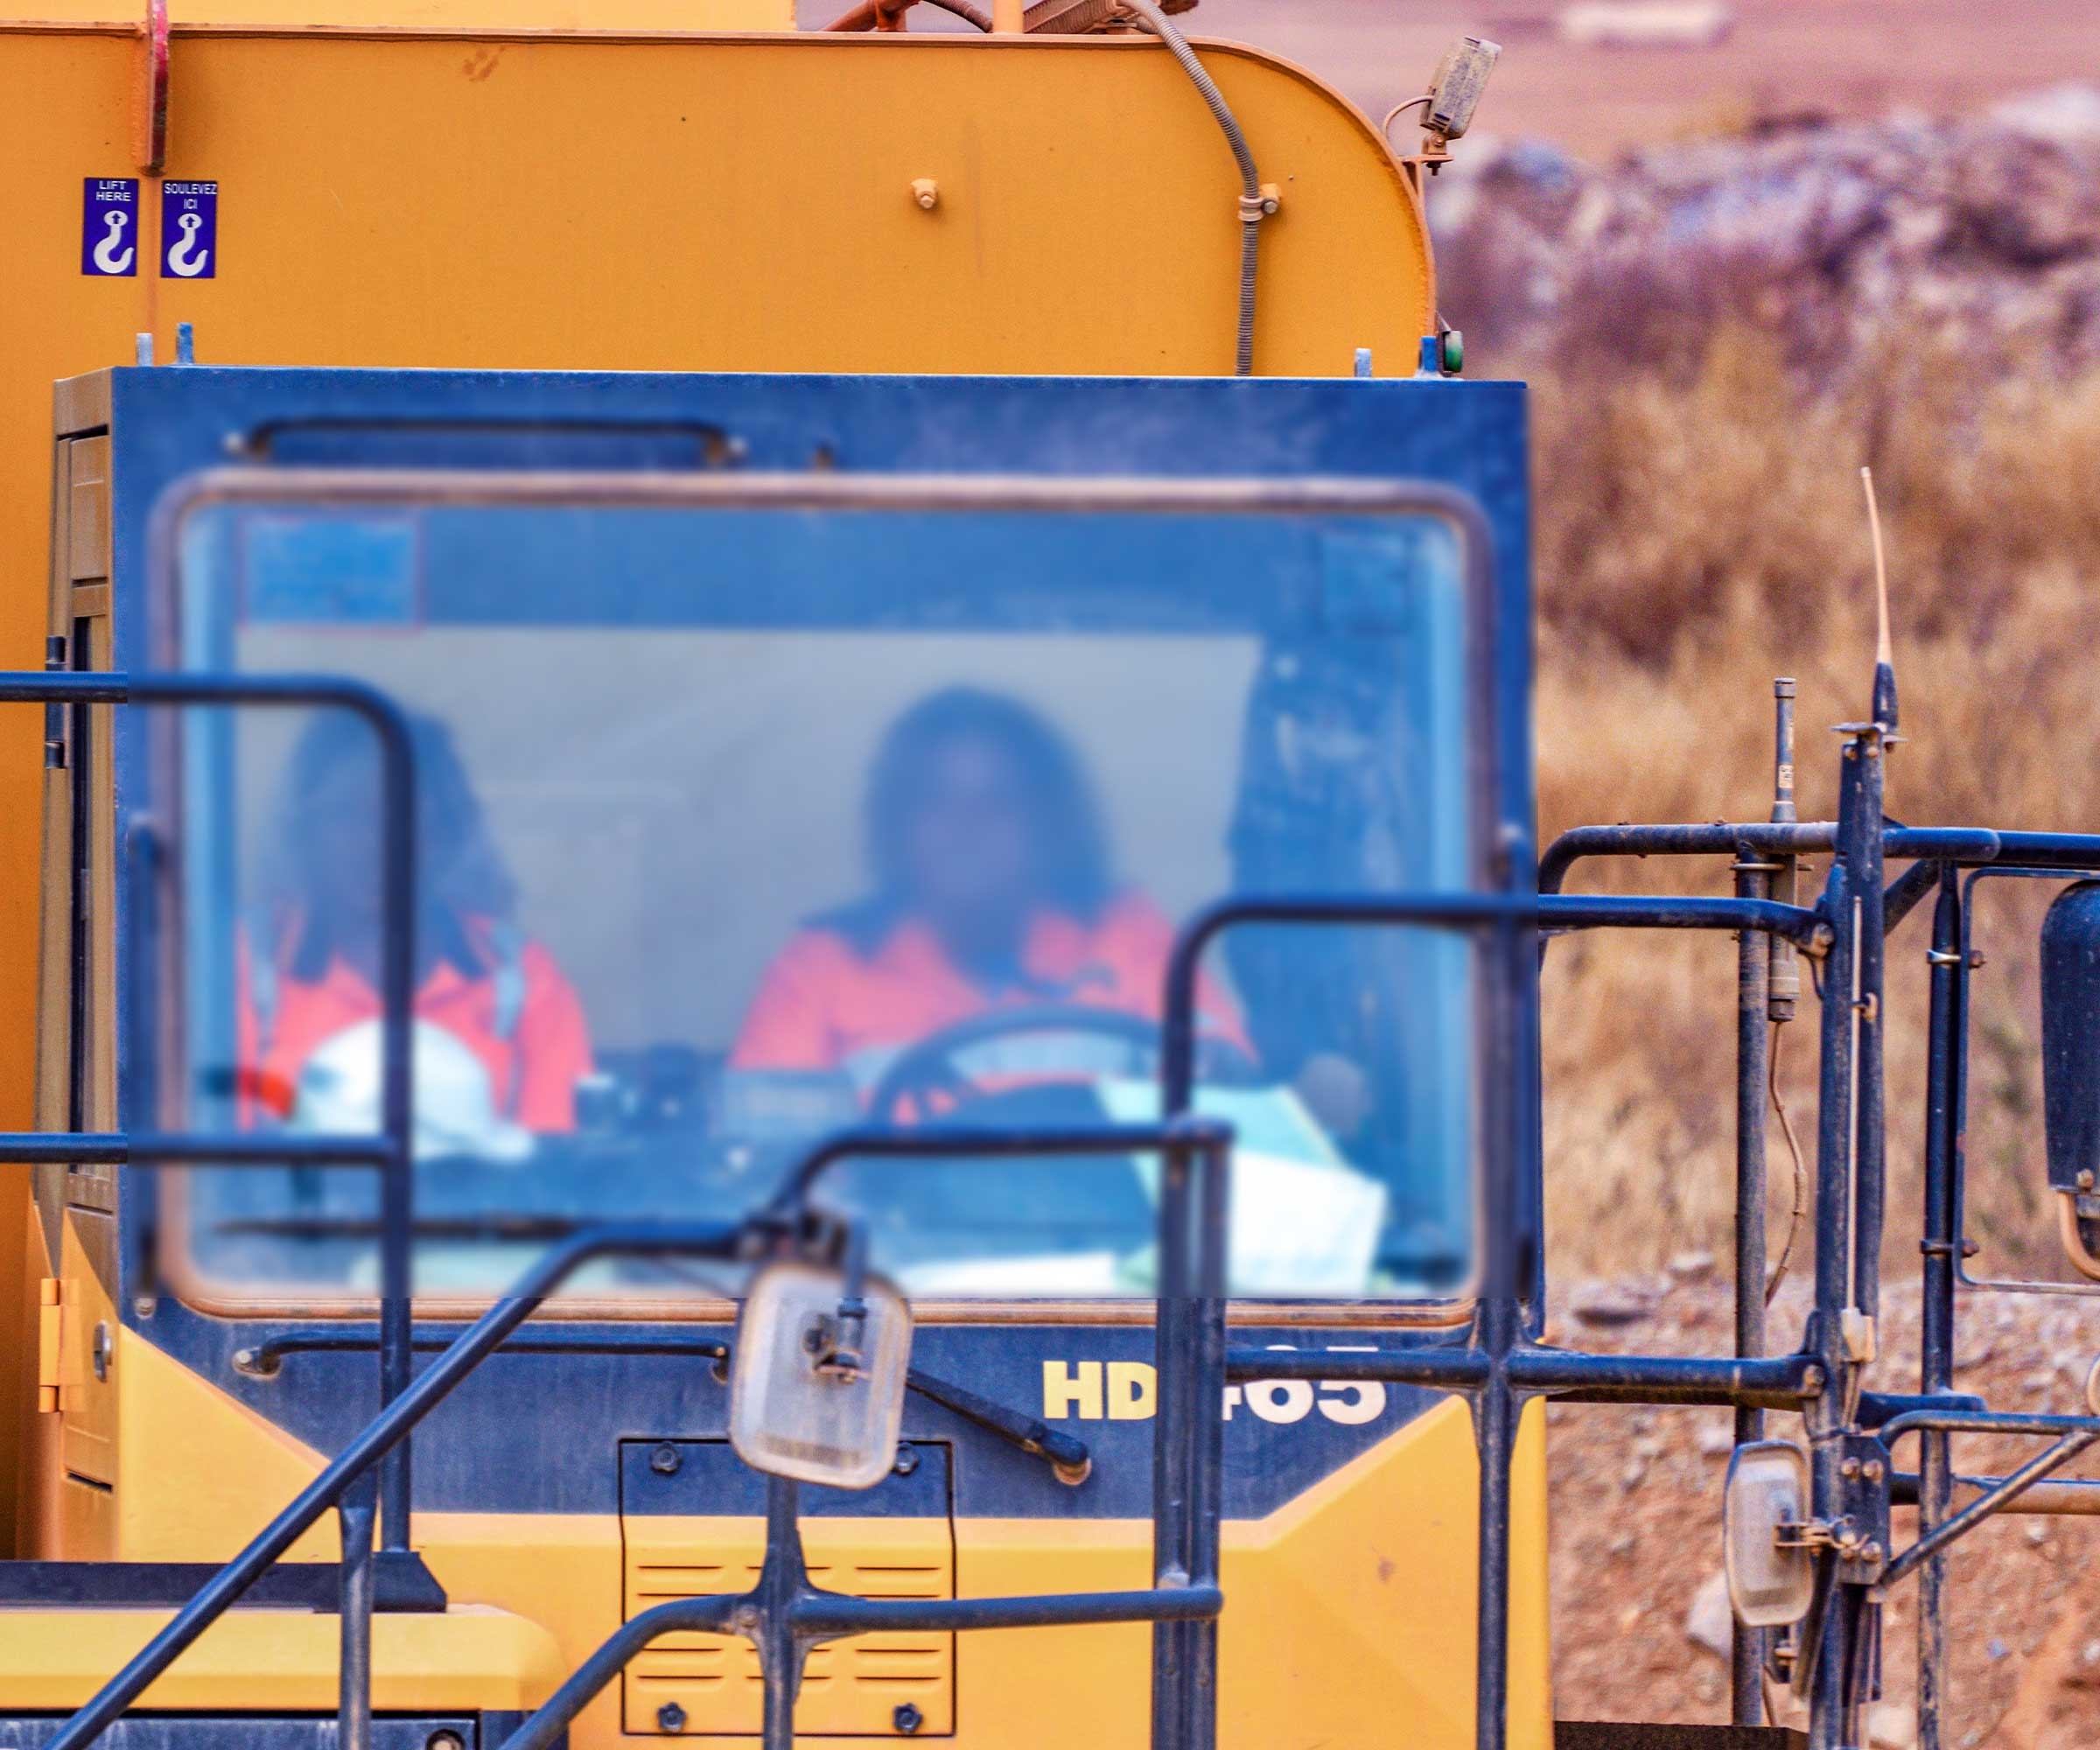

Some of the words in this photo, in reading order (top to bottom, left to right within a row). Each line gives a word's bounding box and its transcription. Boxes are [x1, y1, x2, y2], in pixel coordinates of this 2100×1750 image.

[98, 180, 127, 190] LIFT
[164, 183, 218, 195] SOULEVEZ
[95, 191, 131, 202] HERE
[183, 198, 198, 210] ICI
[1043, 1344, 1387, 1424] HD65
